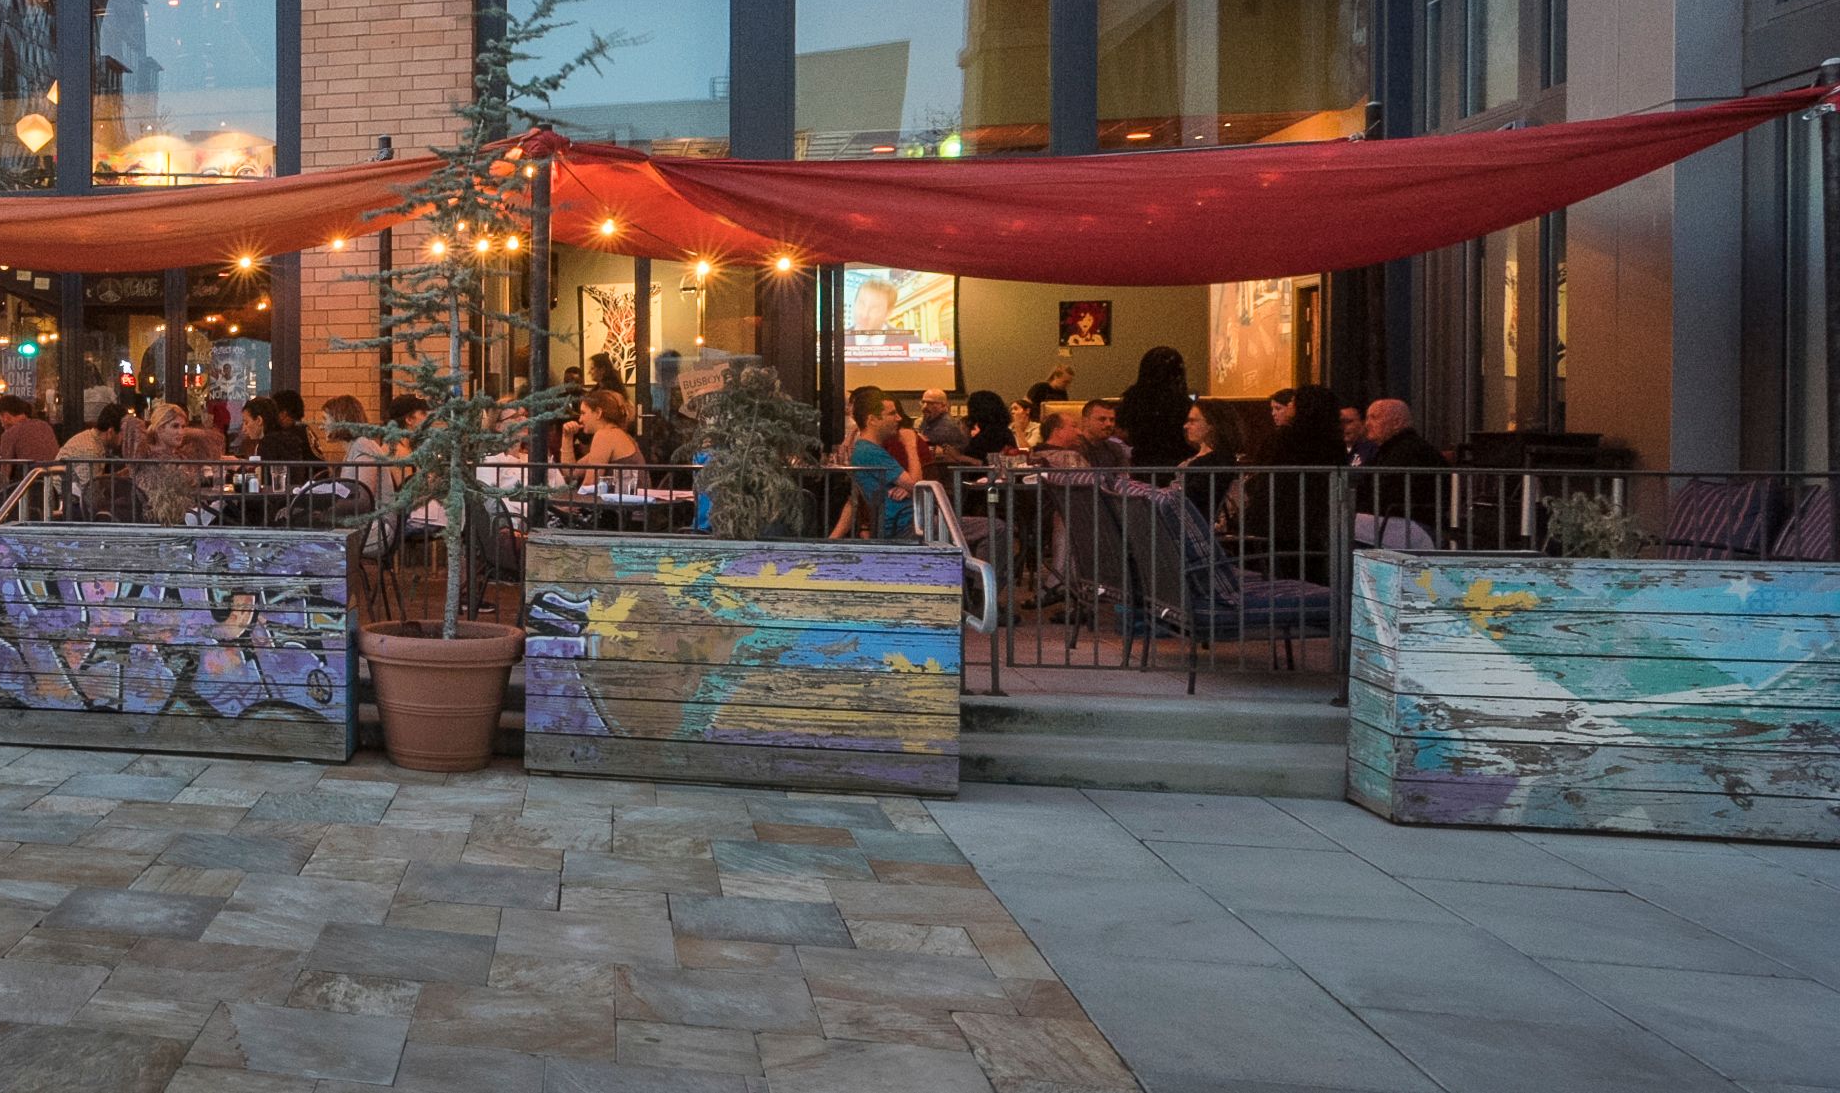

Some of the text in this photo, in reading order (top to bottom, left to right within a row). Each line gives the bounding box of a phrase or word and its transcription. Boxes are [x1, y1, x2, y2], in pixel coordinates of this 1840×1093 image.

[7, 356, 33, 370] NOT
[7, 371, 33, 387] ONE
[682, 374, 721, 390] BUSBOY
